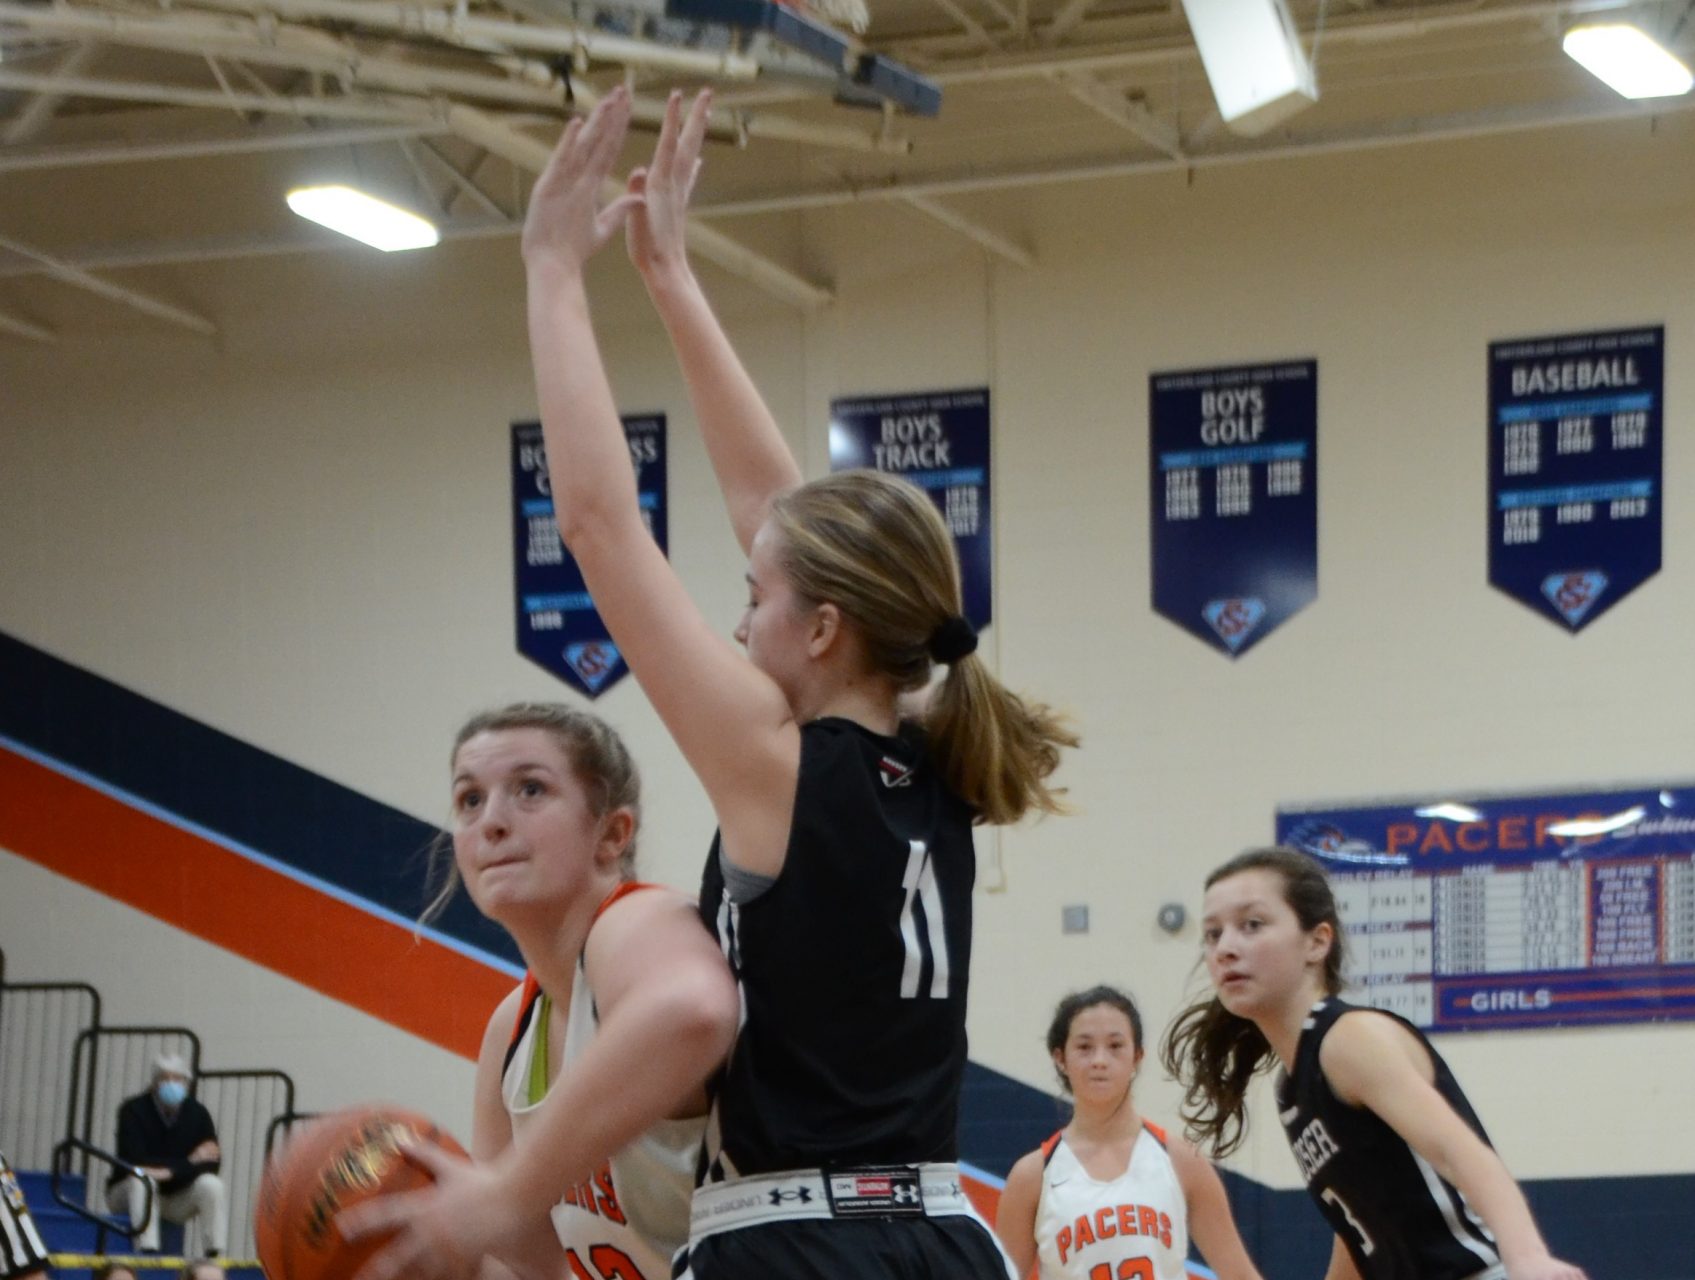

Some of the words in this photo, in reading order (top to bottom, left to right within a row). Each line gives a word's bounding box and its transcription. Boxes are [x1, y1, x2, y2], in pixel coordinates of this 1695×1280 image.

[1511, 355, 1640, 397] BASEBALL
[1201, 385, 1264, 419] BOYS
[880, 413, 942, 444] BOYS
[1200, 415, 1265, 446] GOLF
[873, 439, 950, 472] TRACK
[1470, 989, 1552, 1013] GIRLS
[1056, 1203, 1172, 1266] PACERS
